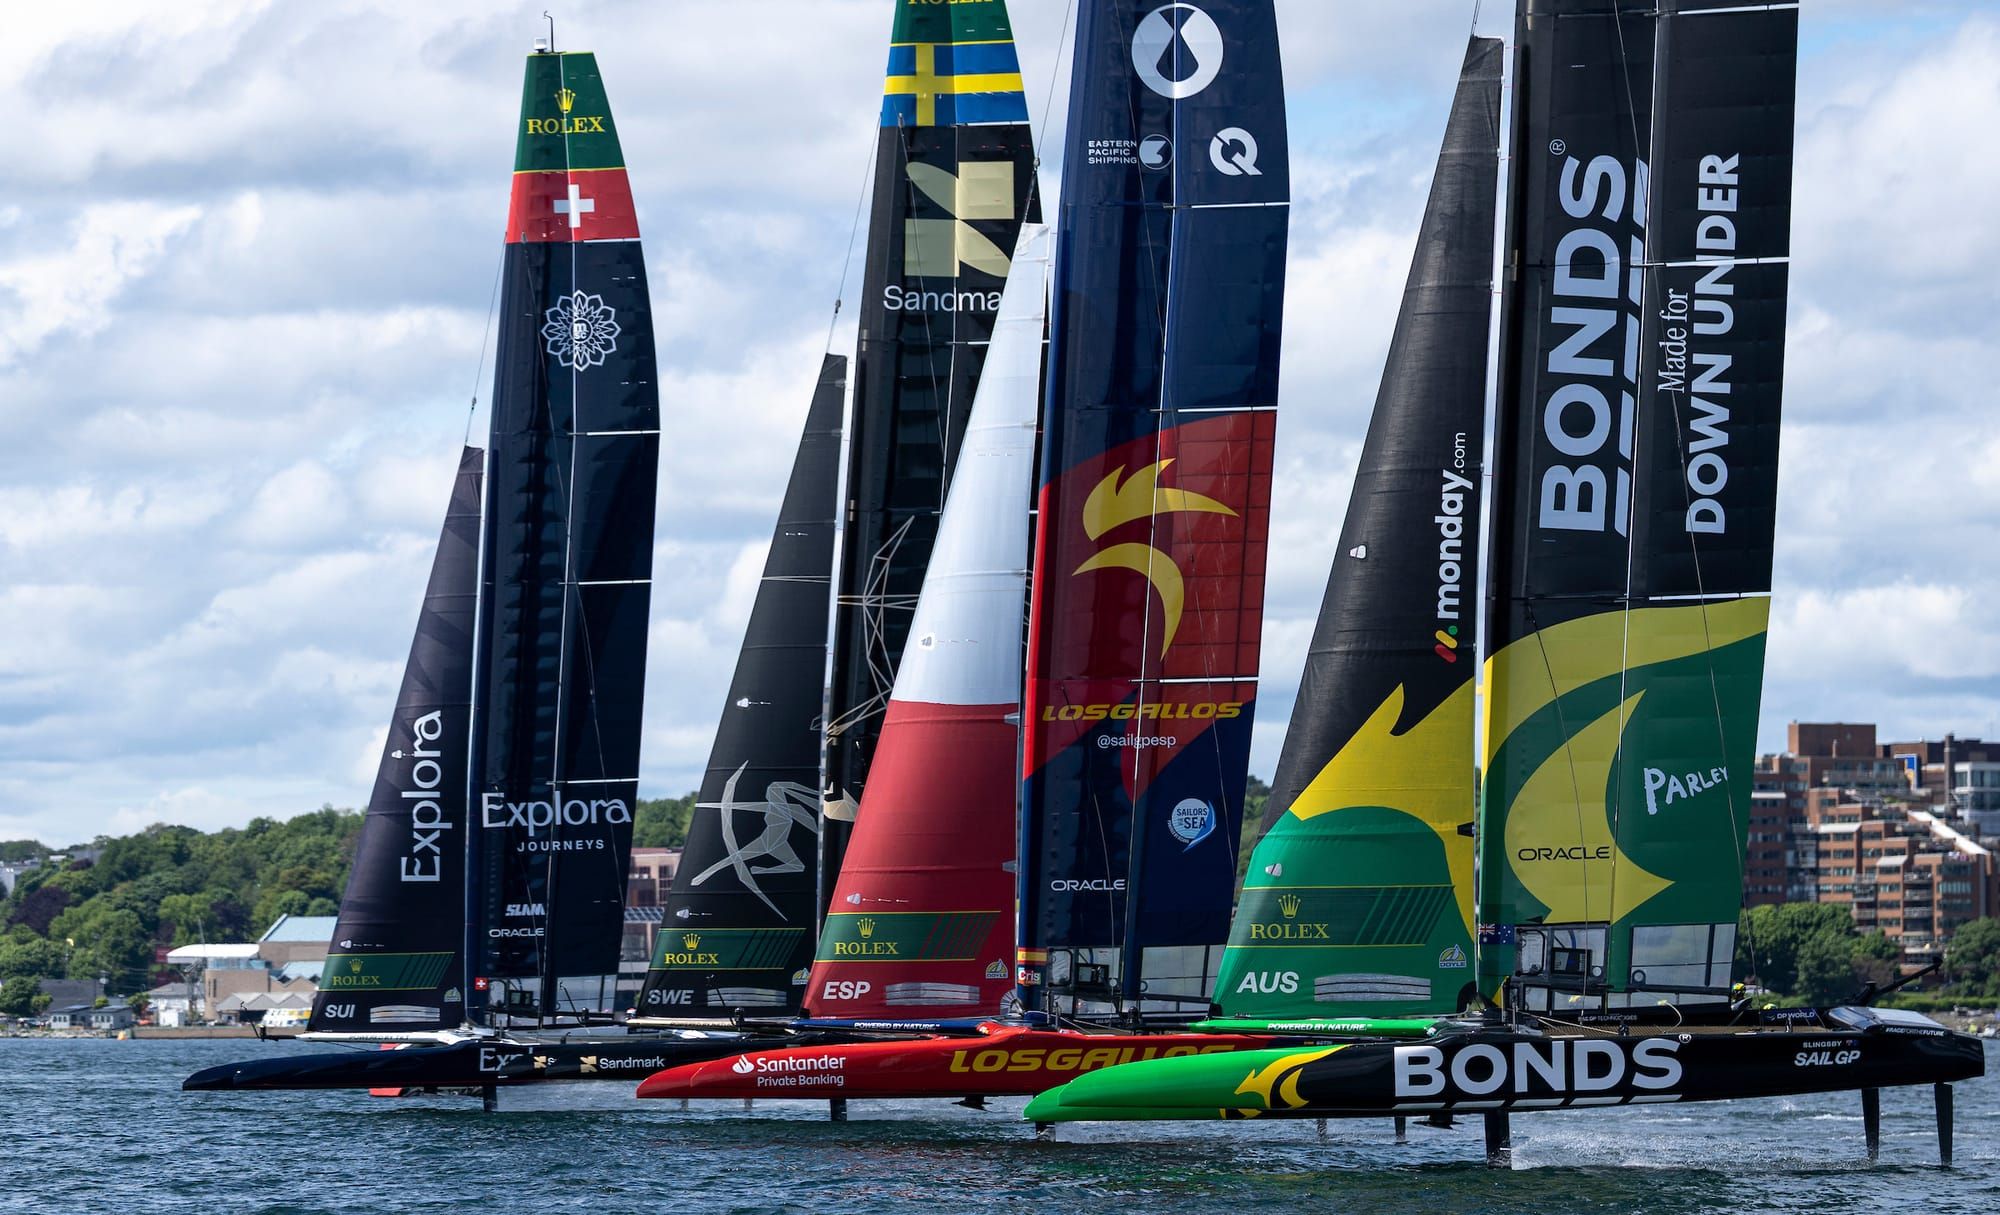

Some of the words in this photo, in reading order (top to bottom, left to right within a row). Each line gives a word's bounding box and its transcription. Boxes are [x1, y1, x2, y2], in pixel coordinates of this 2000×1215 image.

[527, 116, 605, 135] ROLEX
[1088, 140, 1137, 148] EASTERN
[1088, 157, 1137, 165] SHIPPING
[1693, 152, 1740, 335] UNDER
[883, 285, 1002, 312] Sandma
[1659, 288, 1689, 322] for
[1657, 327, 1688, 394] Made
[1685, 353, 1733, 535] DOWN
[1042, 702, 1243, 721] LOSGALLOS
[1097, 733, 1177, 749] @sailgpesp
[401, 710, 453, 882] Explora
[1643, 766, 1729, 815] PARLEY
[482, 791, 632, 837] Explora
[1176, 807, 1208, 817] SAILORS
[1183, 816, 1207, 829] SEA
[516, 839, 605, 852] JOURNEYS
[1518, 846, 1611, 861] ORACLE
[1050, 878, 1127, 892] ORACLE
[505, 903, 546, 916] SLAM
[488, 927, 545, 938] ORACLE
[1250, 924, 1330, 939] ROLEX
[834, 942, 898, 956] ROLEX
[664, 953, 720, 965] ROLEX
[331, 975, 381, 987] ROLEX
[1236, 971, 1300, 994] AUS
[647, 990, 695, 1006] SWE
[822, 981, 872, 1000] ESP
[324, 1004, 356, 1019] SUI
[1788, 1011, 1815, 1019] WORLD
[854, 1022, 892, 1030] POWERED
[1267, 1023, 1313, 1031] POWERED
[1313, 1023, 1328, 1032] BY
[1803, 1040, 1842, 1049] SLINGSBY
[599, 1056, 665, 1070] Sandmark
[756, 1055, 846, 1073] Santander
[950, 1045, 1235, 1072] LOSGA
[757, 1076, 797, 1087] Private
[798, 1074, 844, 1087] Banking
